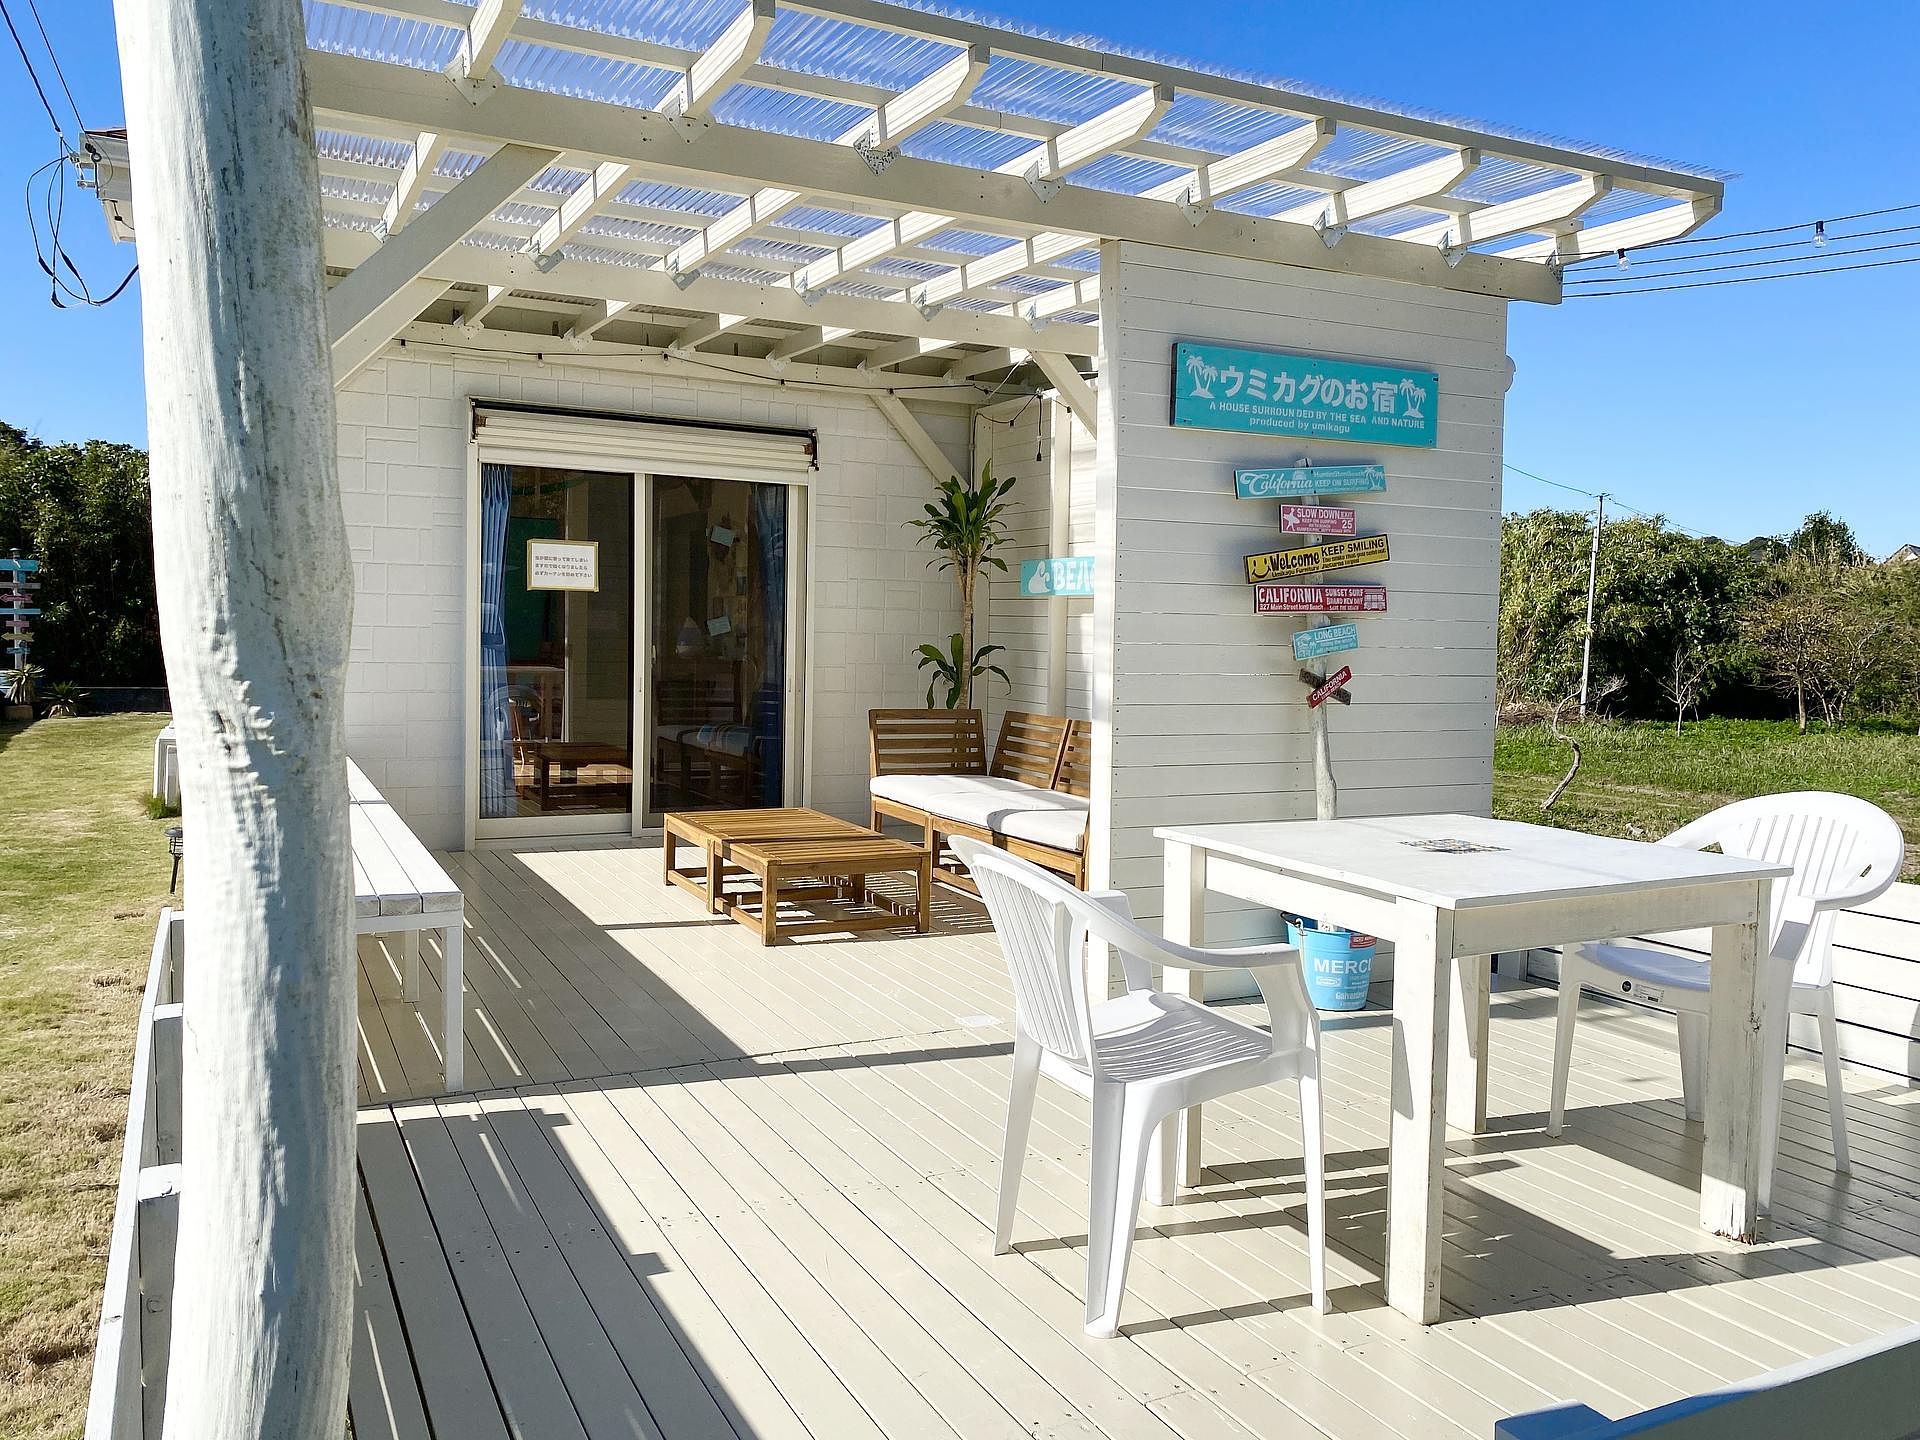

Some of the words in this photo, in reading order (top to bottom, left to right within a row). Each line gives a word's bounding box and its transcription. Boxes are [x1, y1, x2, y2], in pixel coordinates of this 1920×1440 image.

[1220, 365, 1397, 414] ウミカグのお宿
[1209, 402, 1216, 411] A
[1219, 402, 1250, 413] HOUSE
[1316, 411, 1327, 419] BY
[1330, 412, 1347, 421] THE
[1350, 414, 1366, 424] SEA
[1372, 416, 1389, 425] AND
[1392, 418, 1425, 429] NATURE
[1249, 418, 1295, 428] produced
[1298, 420, 1309, 431] by
[1312, 423, 1350, 434] umikagu
[1240, 472, 1313, 496] California
[1314, 480, 1330, 488] KEEP
[1297, 508, 1317, 518] SLOW
[1319, 509, 1340, 519] DOWN
[1342, 519, 1353, 529] 25
[1321, 545, 1344, 557] KEEP
[1347, 539, 1384, 552] SMILING
[1270, 552, 1320, 571] Welcome
[1259, 587, 1323, 603] CALIFORNIA
[1325, 589, 1348, 597] SUNSET
[1349, 589, 1364, 597] SURF
[1314, 629, 1333, 640] LONG
[1334, 625, 1356, 638] BEACH
[1312, 671, 1347, 701] CALIFORNIA
